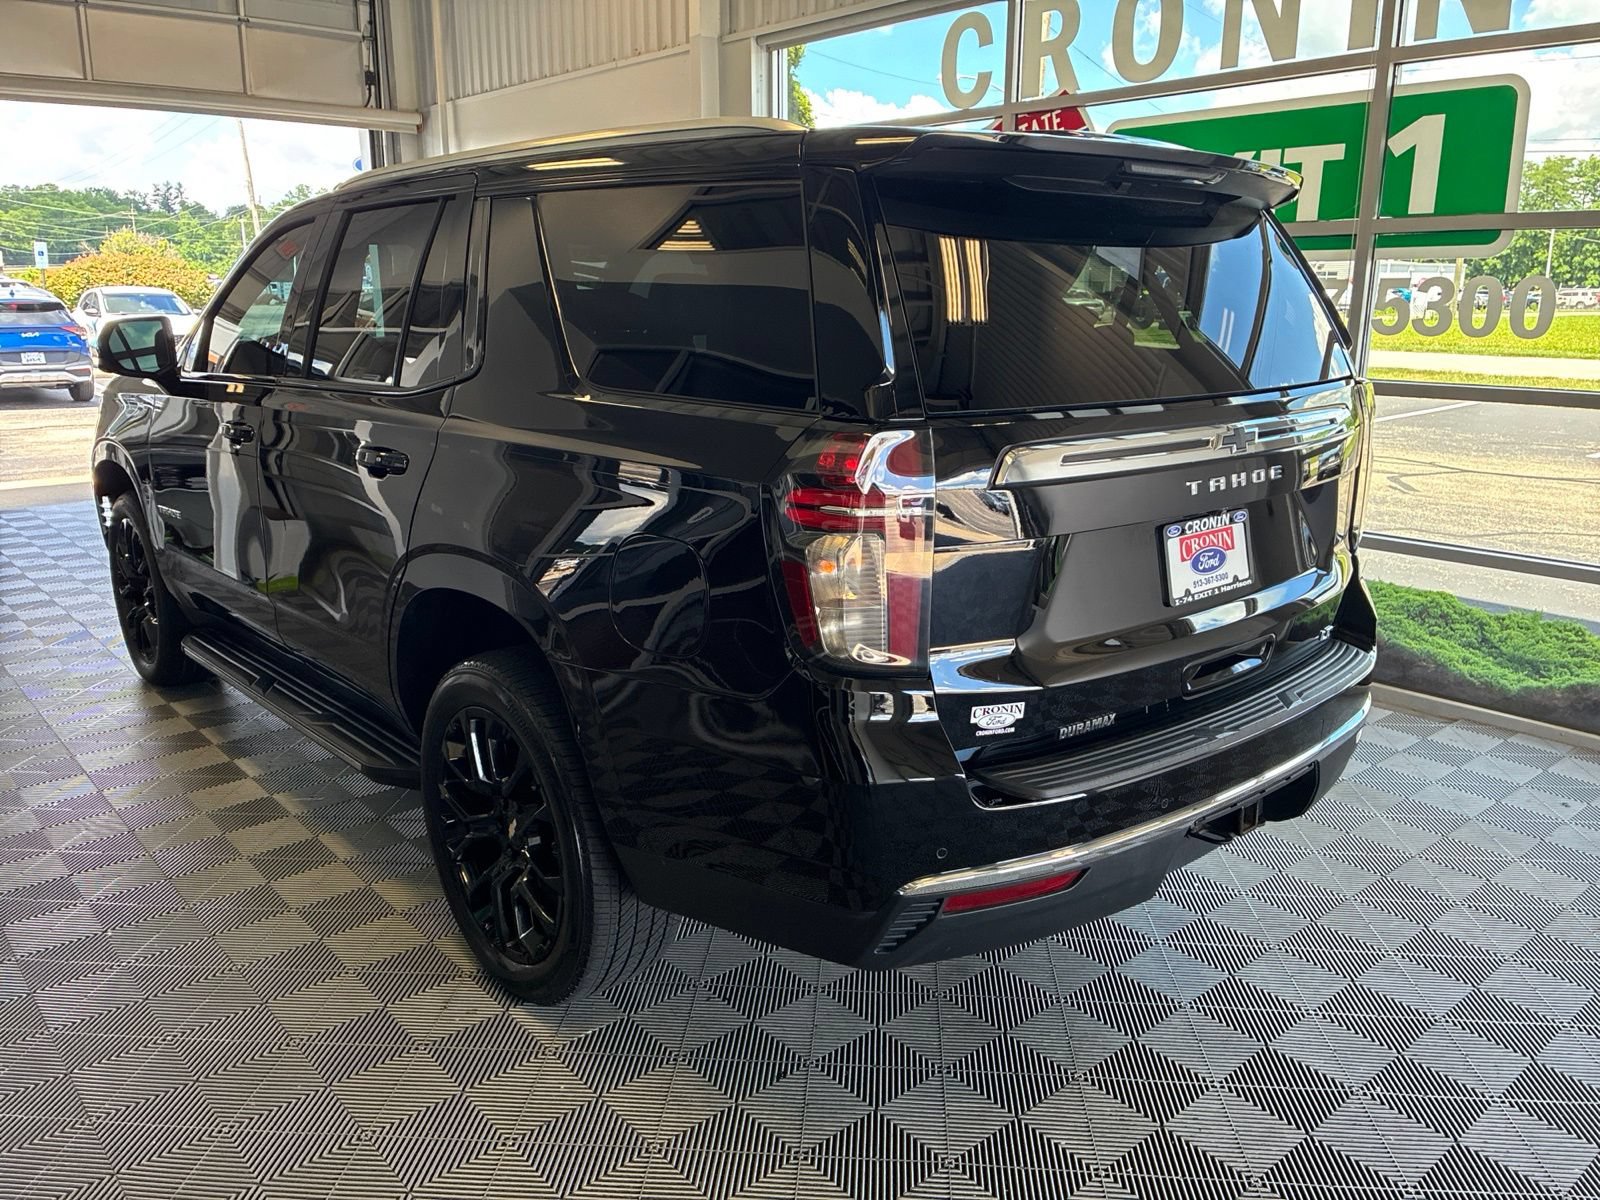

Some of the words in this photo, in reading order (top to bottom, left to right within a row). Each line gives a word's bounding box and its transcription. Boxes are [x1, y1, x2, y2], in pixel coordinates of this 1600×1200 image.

[1387, 113, 1446, 214] 1
[1185, 465, 1283, 496] TAHOE
[1184, 513, 1230, 534] CRONIN
[1181, 529, 1232, 560] CRONIN
[1198, 551, 1220, 570] Ford
[1192, 572, 1229, 589] 513-367-5300
[1175, 595, 1193, 606] I-74
[1194, 589, 1213, 600] EXIT
[1220, 579, 1252, 593] Harrison
[973, 703, 1023, 719] CRONIN
[985, 715, 1007, 726] Ford
[975, 727, 1015, 737] CRONINFORD.COM
[1059, 713, 1116, 740] DURAMAX
